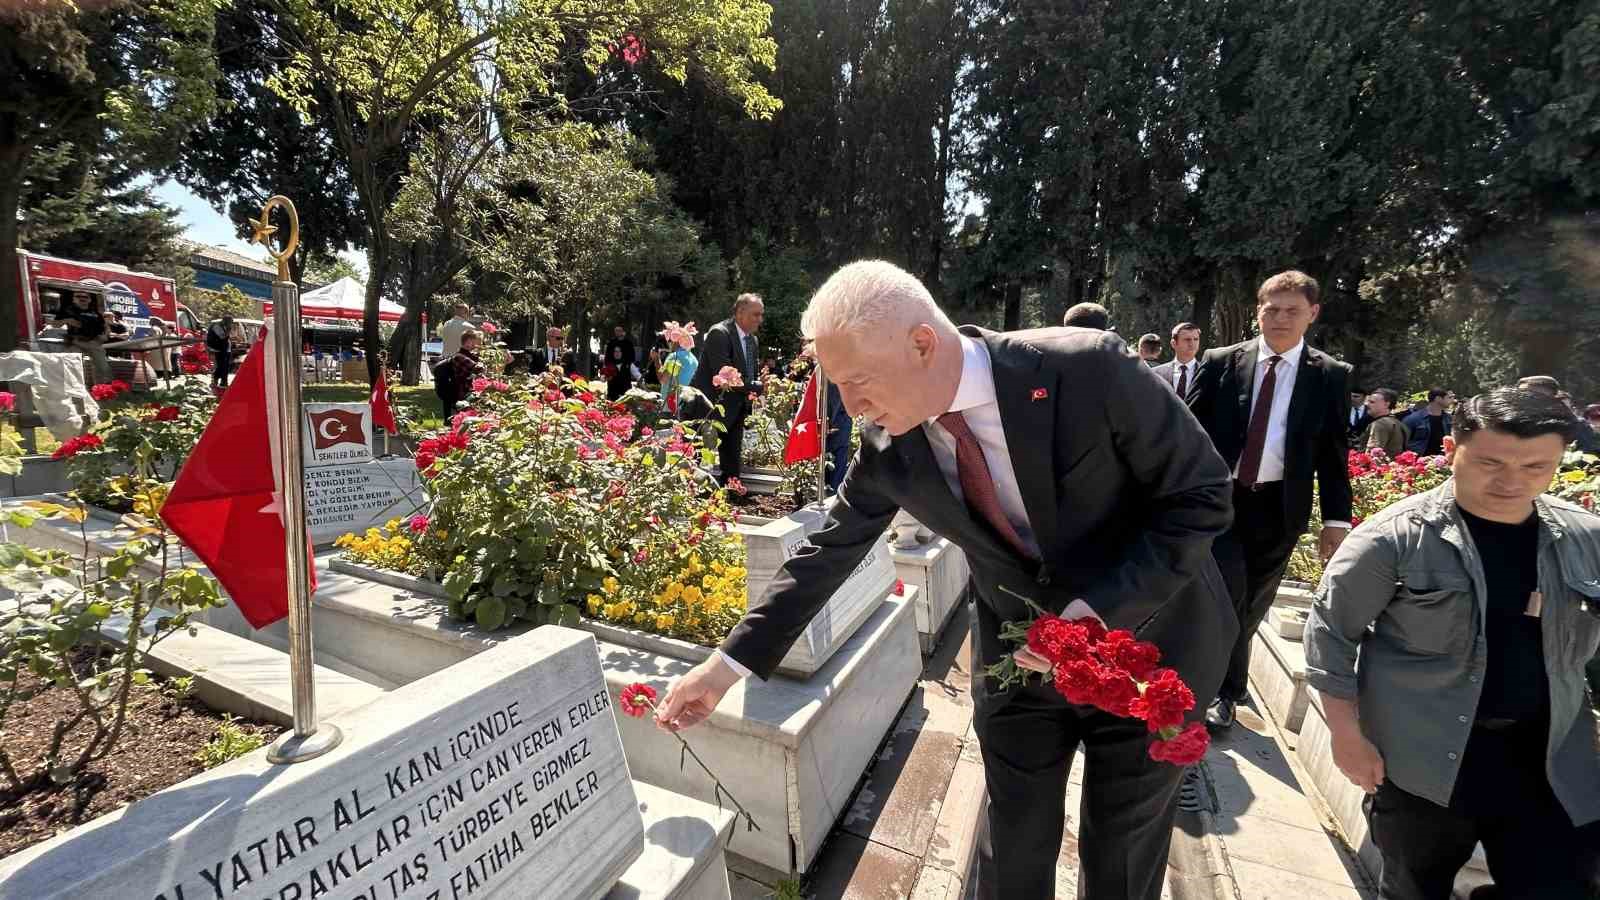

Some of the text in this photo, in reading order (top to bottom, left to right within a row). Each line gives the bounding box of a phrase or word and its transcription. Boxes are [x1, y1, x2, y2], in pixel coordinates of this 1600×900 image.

[198, 701, 523, 900] YATAR AL KAN İÇİNDE
[382, 737, 592, 900] TAŞ TÜRBEYE GİRMEZ
[417, 778, 465, 828] İÇİN
[470, 749, 511, 793] CAN
[511, 717, 563, 766] VEREN
[567, 689, 609, 729] ERLER
[449, 770, 599, 900] FATİHA BEKLER
